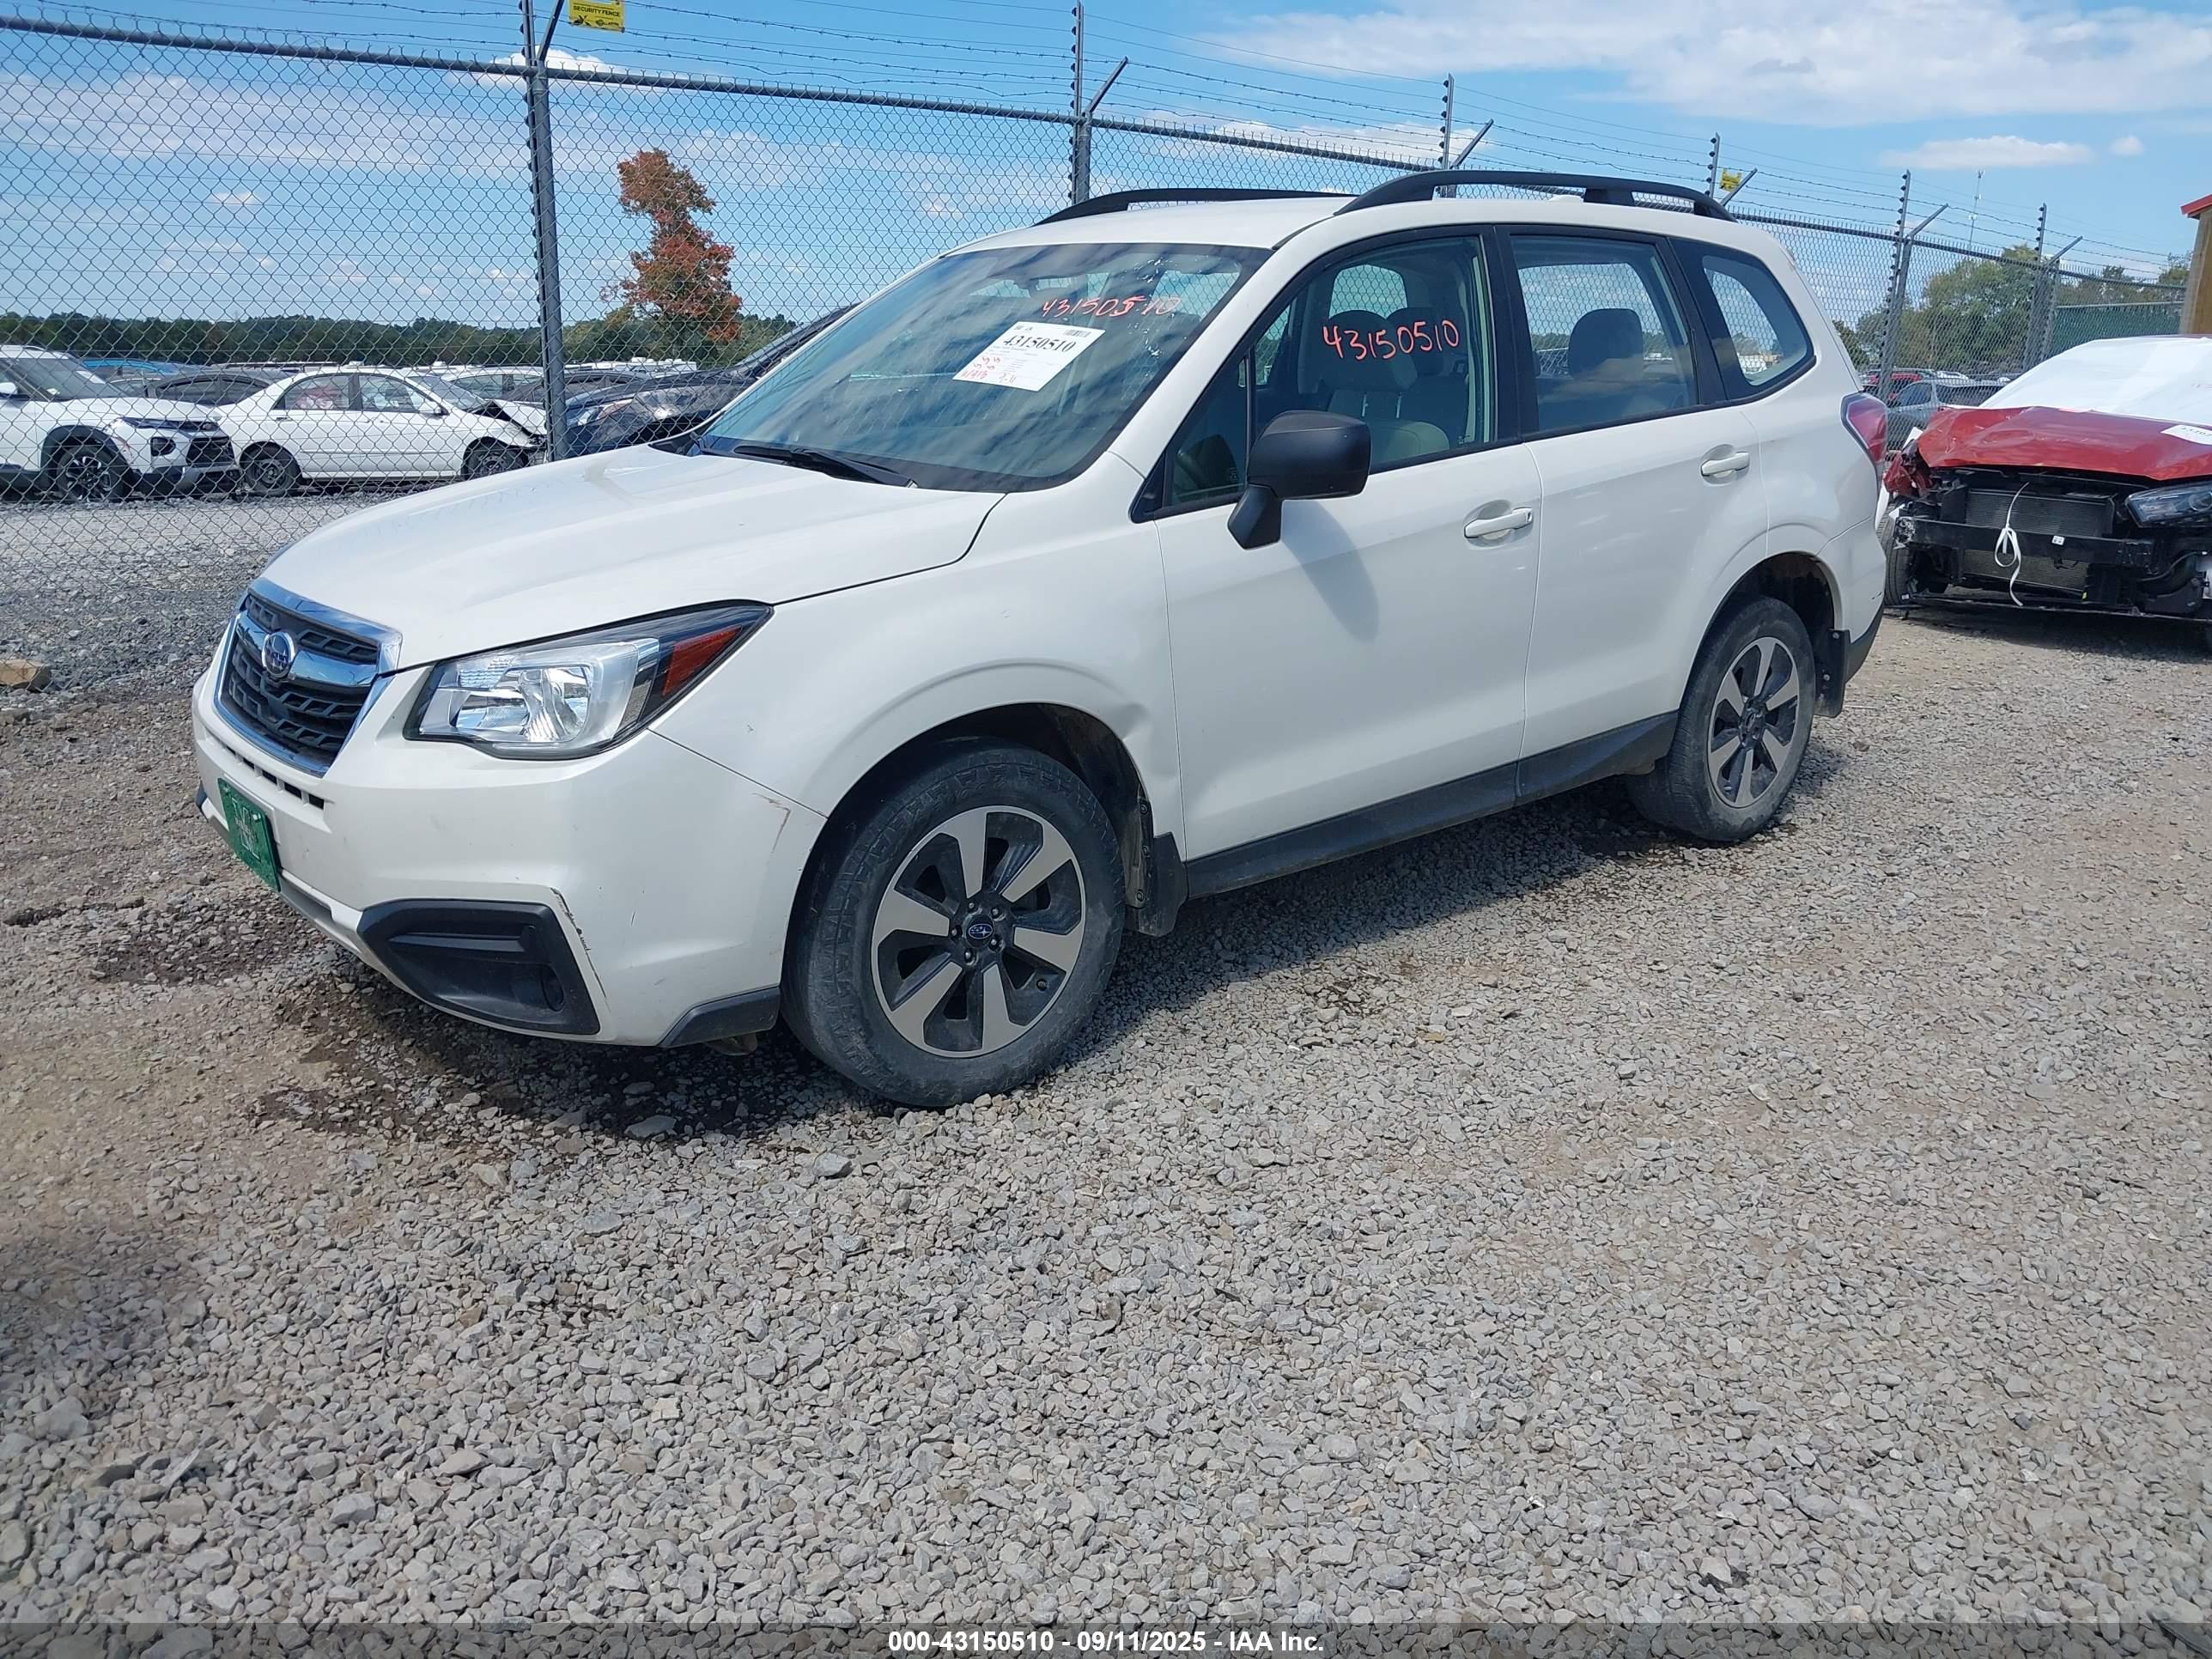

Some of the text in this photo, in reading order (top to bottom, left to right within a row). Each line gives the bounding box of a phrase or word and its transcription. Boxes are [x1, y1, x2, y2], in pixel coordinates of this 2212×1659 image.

[573, 5, 601, 14] SECURITY
[1042, 295, 1181, 318] 43150510
[1003, 334, 1077, 353] 43150510
[1322, 319, 1459, 361] 43150510
